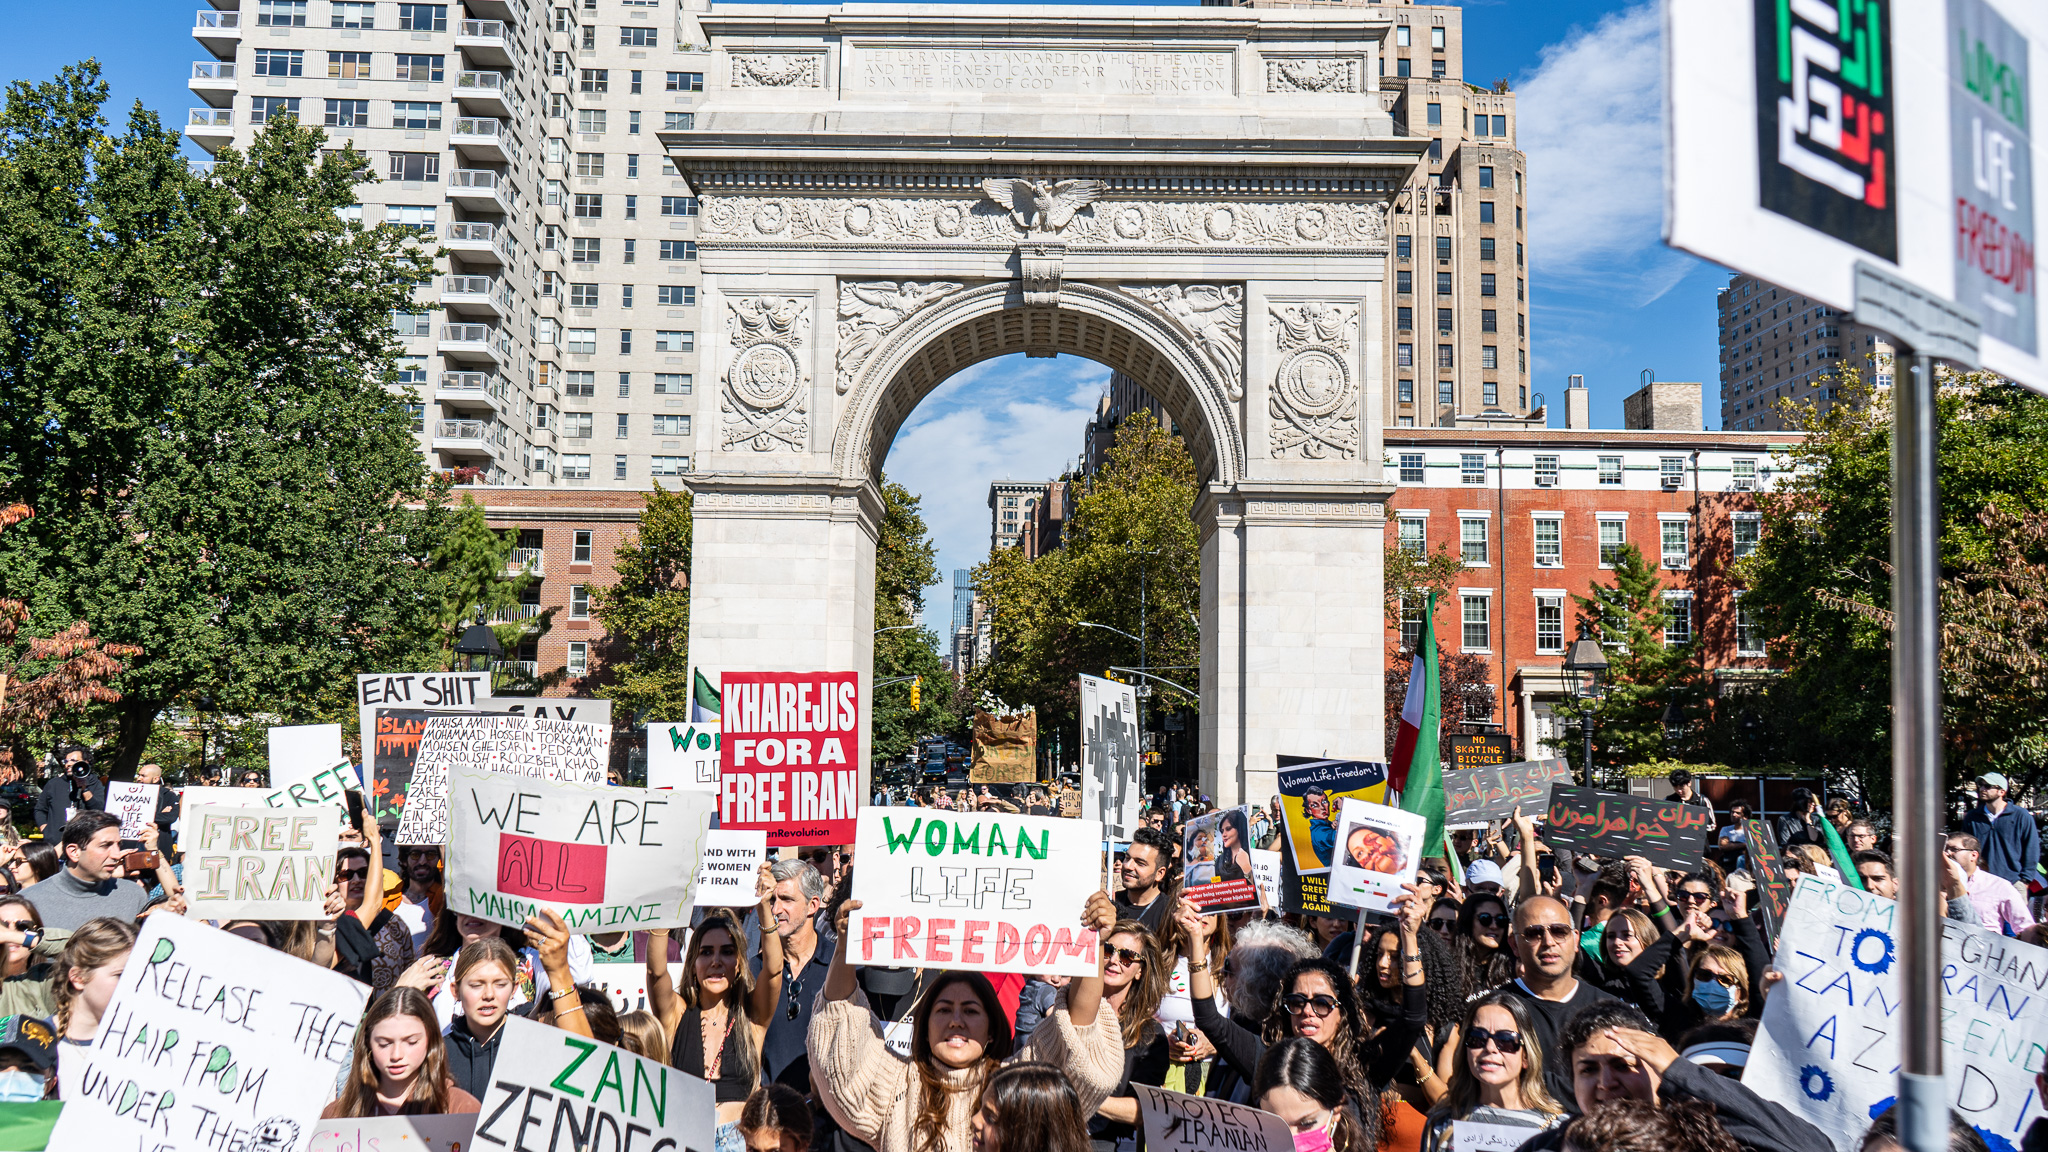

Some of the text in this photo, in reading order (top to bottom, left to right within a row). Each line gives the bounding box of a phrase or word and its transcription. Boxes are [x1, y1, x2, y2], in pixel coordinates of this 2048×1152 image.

[865, 51, 1224, 65] LET US RAISE A STANDARD TO WHICH THE WISE
[864, 64, 1224, 78] AND THE HONEST CAN REPAIR THE EVENT
[864, 77, 1224, 91] IS IN THE HAND OF GOD WASHINGTON
[1971, 116, 2016, 210] LIFE
[362, 676, 481, 706] EAT SHIT
[723, 681, 855, 733] KHAREJIS
[427, 717, 594, 736] MAHSA AMINI NIKA SHAKARAMI
[424, 729, 602, 747] MOHAMMAD HOSSEIN TORKAMAN
[1472, 736, 1486, 744] NO
[418, 751, 489, 764] AZARNOUSH
[501, 752, 558, 766] ROOZBEH
[421, 741, 597, 759] MOHSEN GHEISARI PEDRAM
[734, 737, 846, 766] FOR A
[411, 775, 447, 786] ZAFFA
[417, 763, 439, 774] EMI
[555, 770, 578, 781] ALI
[1526, 760, 1567, 782] برای
[265, 760, 362, 808] FREE
[410, 787, 443, 797] ZARE
[113, 794, 151, 804] WOMAN
[415, 798, 447, 810] SETA
[721, 770, 857, 823] FREE IRAN
[1063, 792, 1075, 801] HER
[121, 812, 142, 822] LIFE
[431, 811, 447, 821] SH
[471, 788, 668, 846] WE ARE
[1548, 800, 1670, 841] خواهرامون
[1658, 803, 1705, 831] برای
[200, 814, 317, 851] FREE
[399, 822, 446, 834] MEHRD
[766, 828, 830, 838] anRevolution
[882, 816, 1049, 860] WOMAN
[397, 834, 446, 844] JAMALZ
[702, 848, 756, 858] AND WITH
[502, 839, 587, 892] ALL
[708, 863, 751, 872] WOMEN
[196, 855, 334, 901] IRAN
[710, 877, 739, 886] IRAN
[910, 866, 1034, 910] LIFE
[1306, 876, 1328, 886] WILL
[1301, 884, 1328, 895] GREET
[1301, 893, 1318, 902] THE
[469, 887, 661, 928] MAHSA AMINI
[1302, 902, 1330, 913] AGAIN
[1796, 877, 1895, 930] FROM
[861, 916, 1097, 967] FREEDOM
[1835, 925, 2030, 1021] TO RAN
[1795, 951, 1902, 1017] ZAN
[136, 937, 355, 1064] RELEASE THE
[99, 1002, 268, 1118] HAIR FROM
[550, 1036, 667, 1128] ZAN
[82, 1063, 249, 1152] UNDER THE
[1147, 1088, 1262, 1132] PROTECT
[1180, 1118, 1268, 1150] IRANIAN
